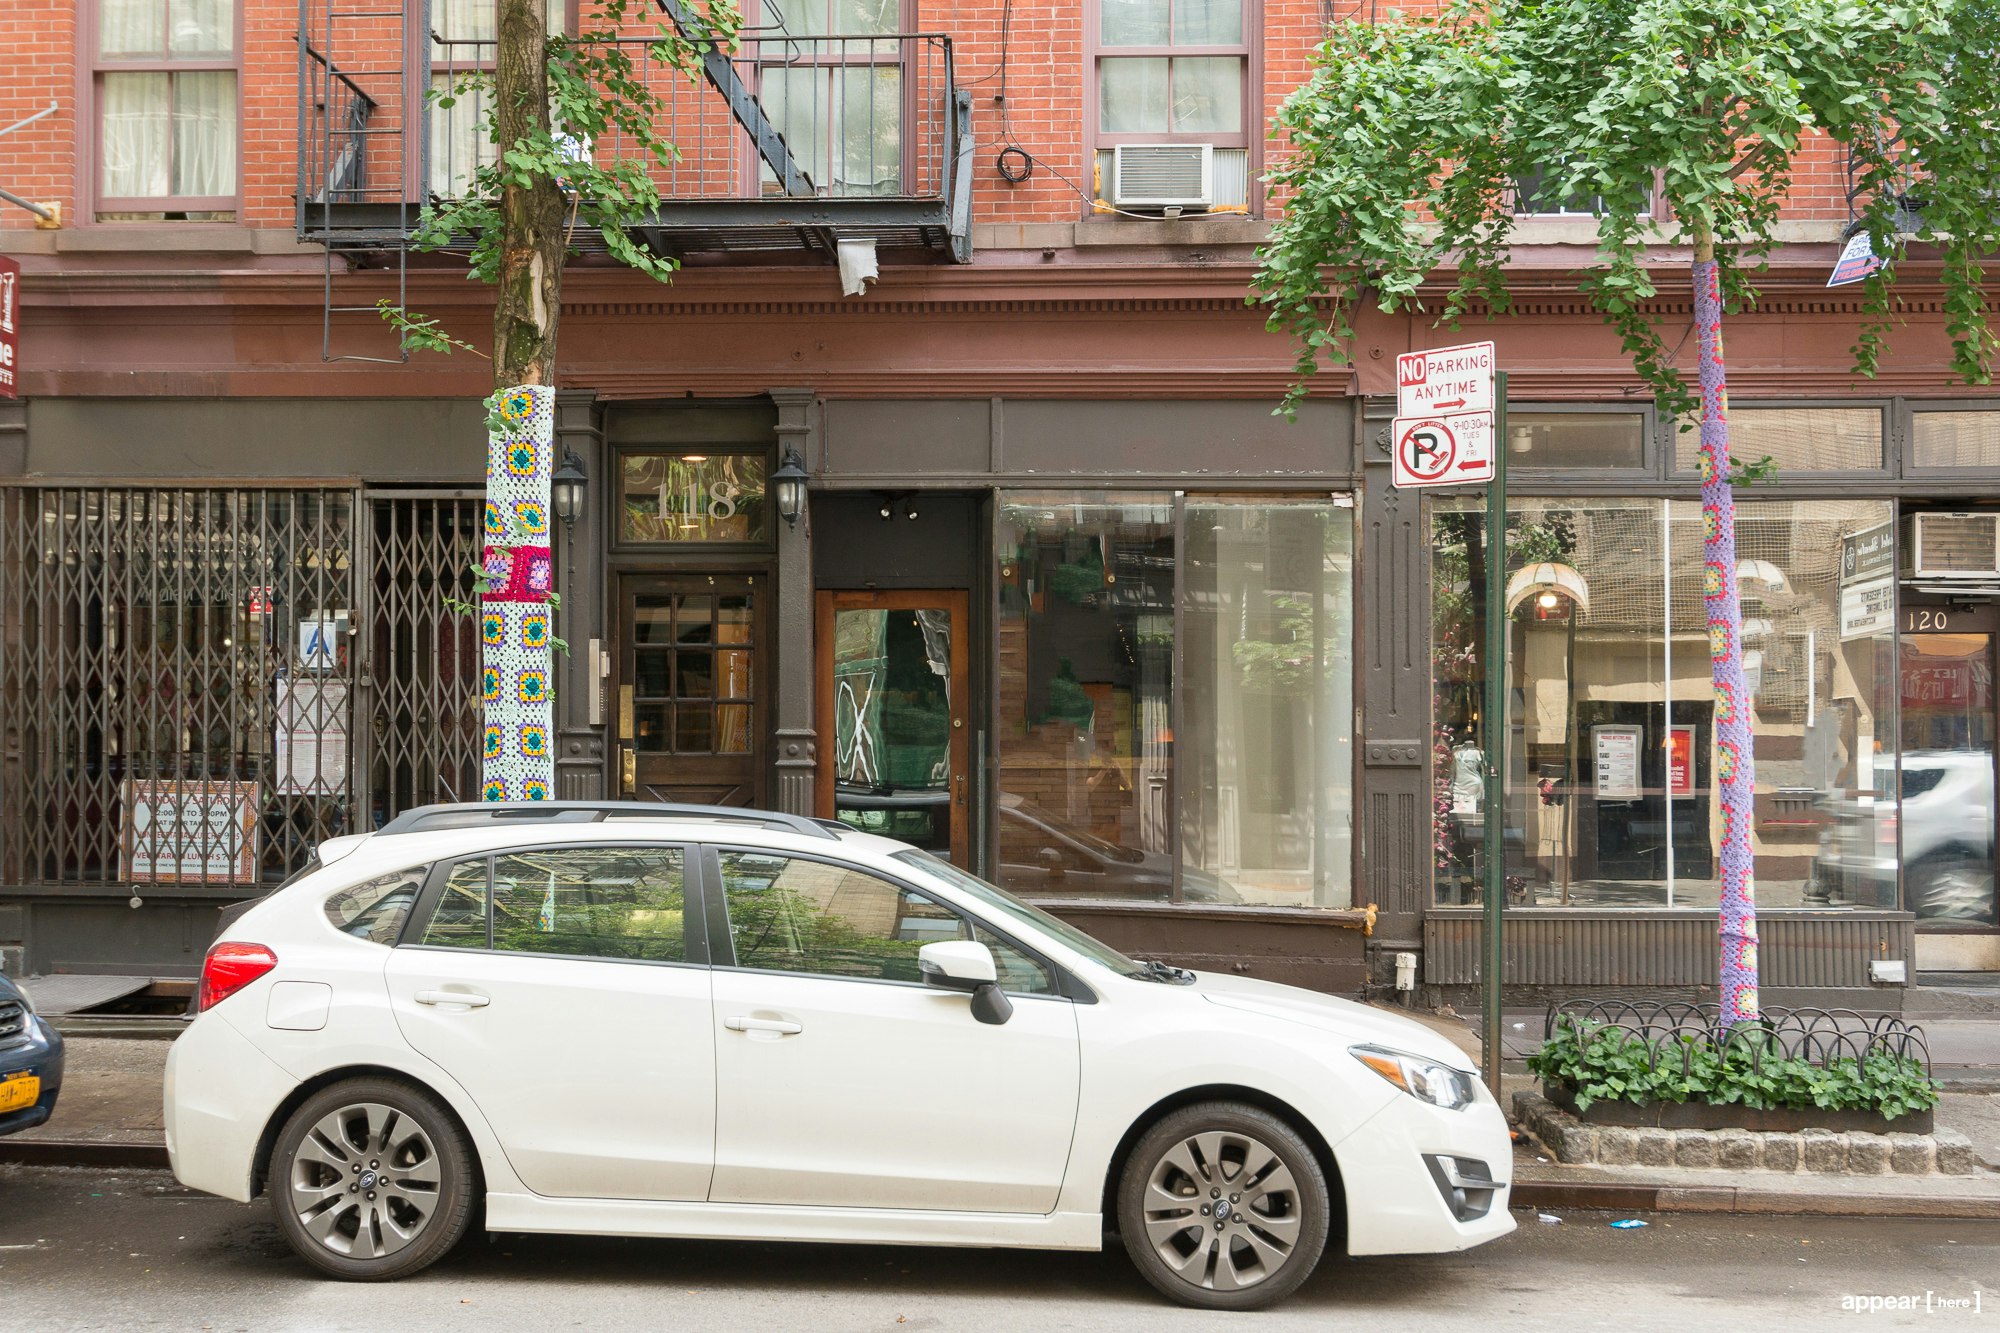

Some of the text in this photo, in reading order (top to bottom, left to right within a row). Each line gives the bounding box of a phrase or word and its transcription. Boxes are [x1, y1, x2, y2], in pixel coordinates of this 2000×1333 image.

[1400, 355, 1488, 383] NO PARKING
[1415, 380, 1477, 400] ANYTIME
[1462, 431, 1480, 440] TUES
[1466, 449, 1478, 457] FRI
[652, 481, 736, 520] 118
[1909, 611, 1948, 630] 120
[304, 628, 331, 655] A
[139, 796, 242, 805] MONDA SAURDY
[136, 852, 185, 860] VEGTARN
[187, 852, 213, 860] LUH
